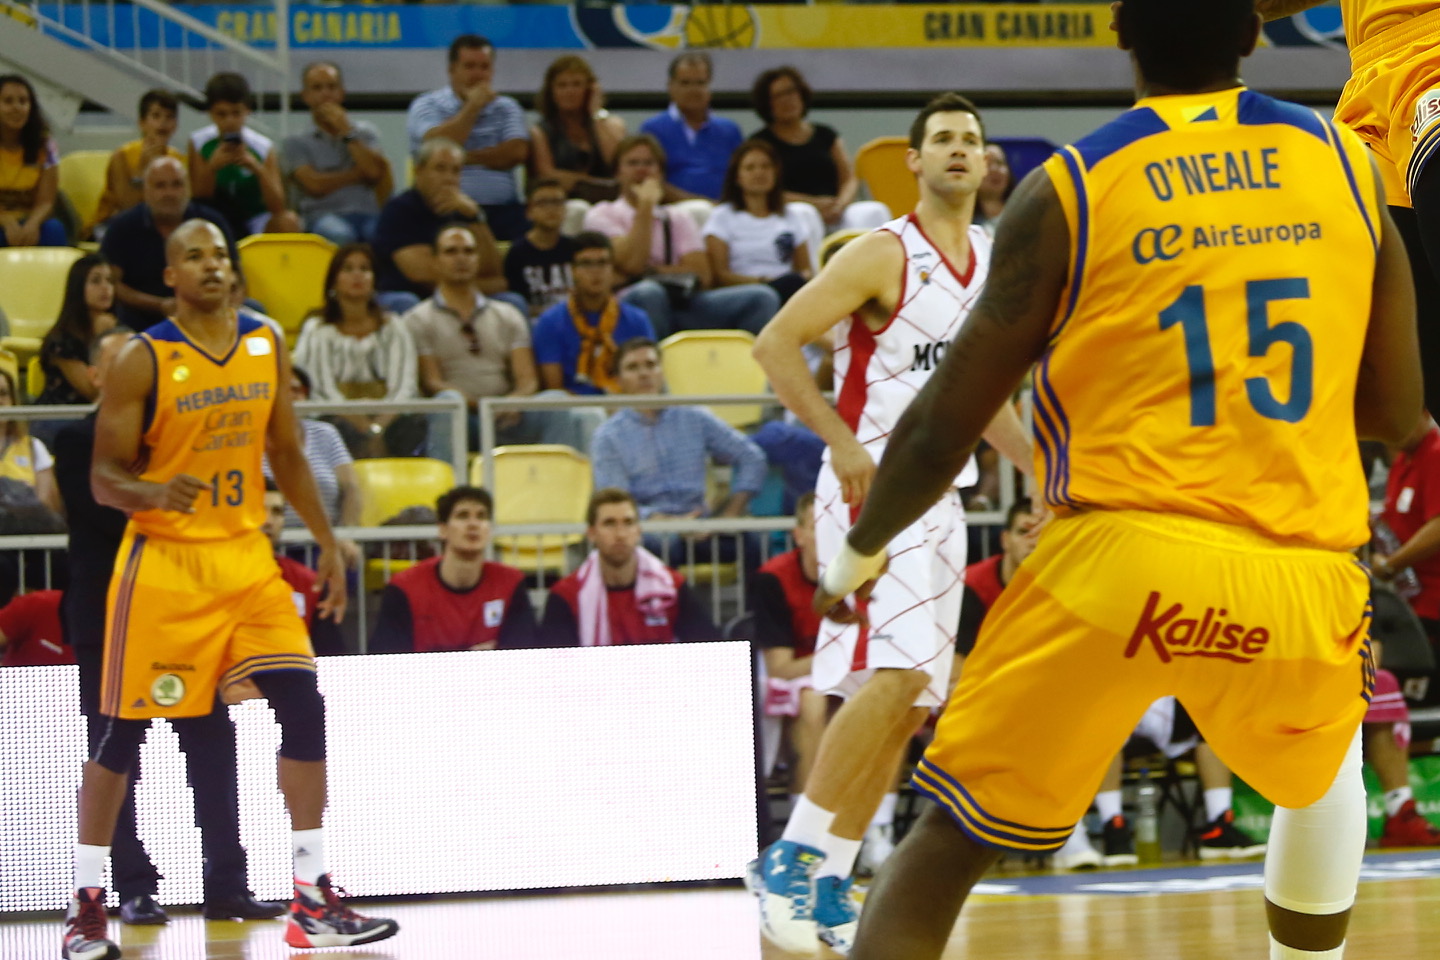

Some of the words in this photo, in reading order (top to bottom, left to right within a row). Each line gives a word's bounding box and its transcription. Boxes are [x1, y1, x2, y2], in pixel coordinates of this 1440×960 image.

[294, 10, 401, 42] CANARIA
[923, 10, 984, 41] GRAN
[995, 10, 1095, 41] CANARIA
[1143, 147, 1281, 202] O'NEALE
[1158, 277, 1315, 428] 15
[176, 381, 271, 414] HERBALIFE
[210, 469, 245, 508] 13
[1123, 590, 1270, 664] Kalise
